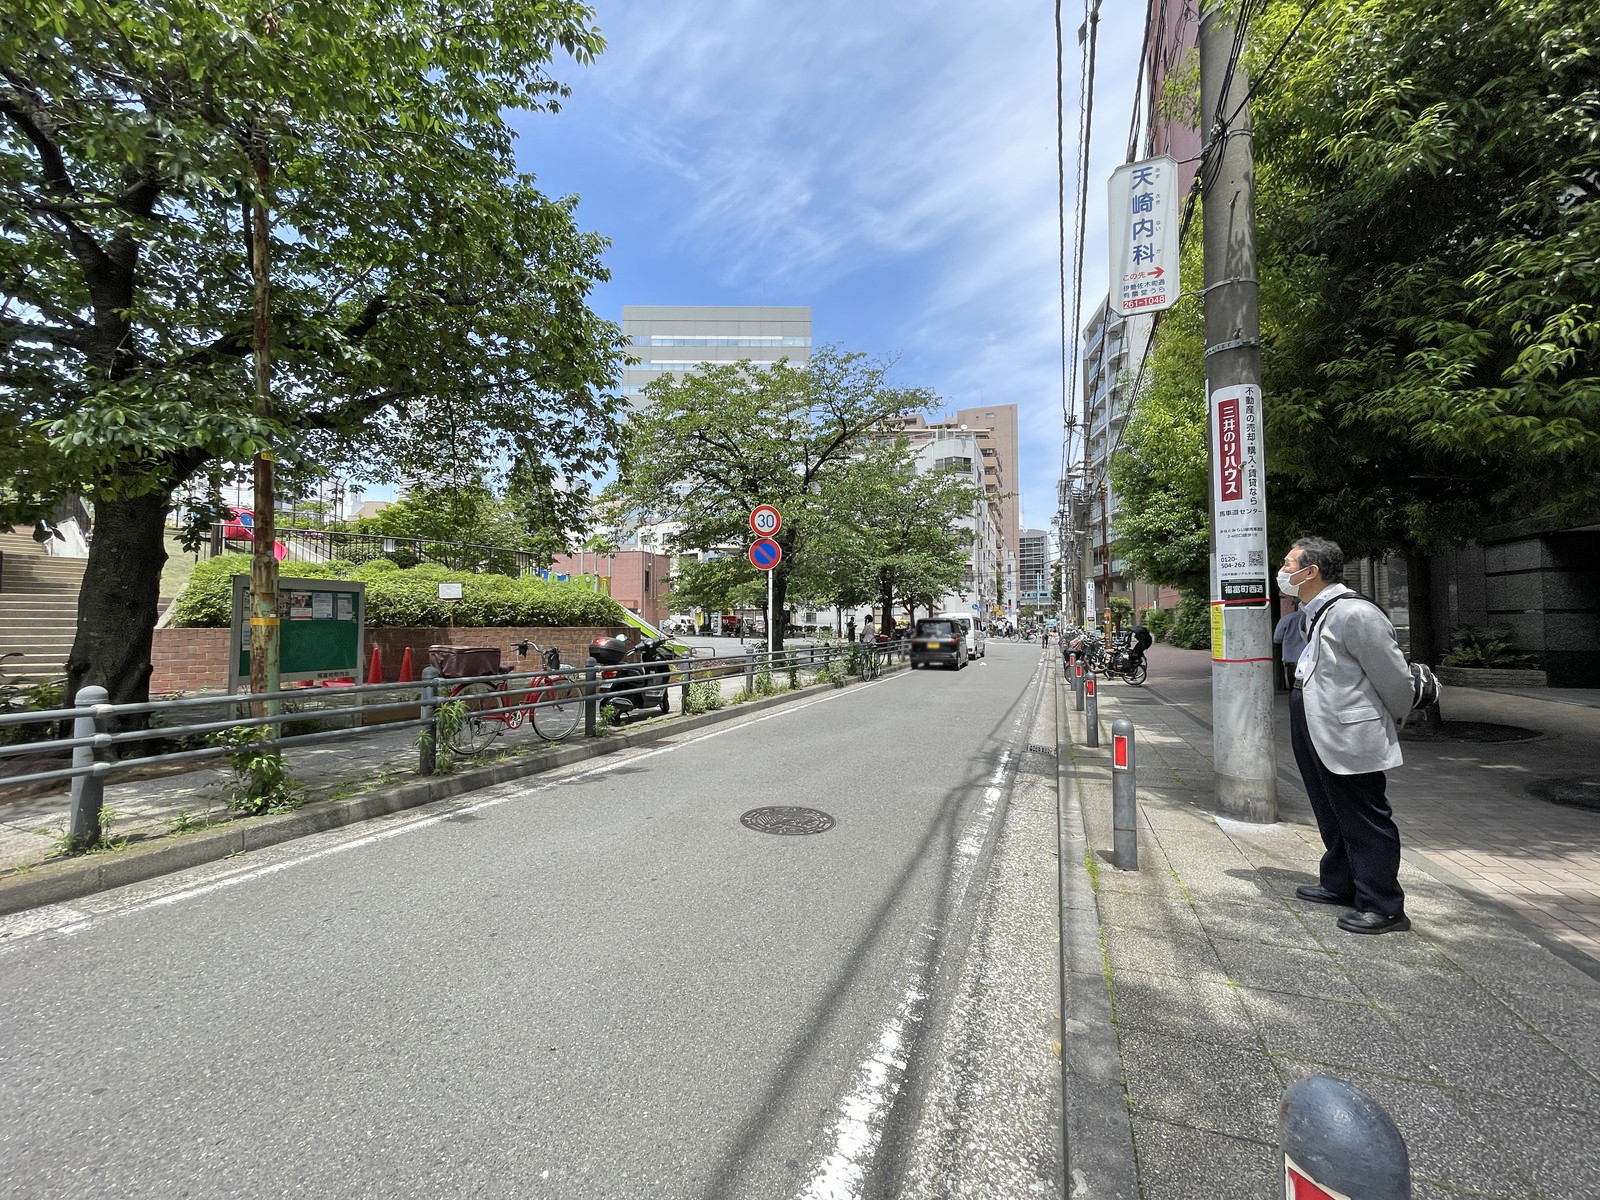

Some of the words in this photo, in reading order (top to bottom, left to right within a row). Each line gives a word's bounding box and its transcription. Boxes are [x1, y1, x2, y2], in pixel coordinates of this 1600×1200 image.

[1131, 166, 1155, 265] 天崎内科
[1123, 271, 1146, 281] この先
[1123, 295, 1165, 309] 261-1048
[1223, 405, 1238, 495] 三井のリハウス
[1245, 386, 1258, 506] 不動産の売却・購入・賃貸なら
[1219, 508, 1262, 517] 馬車道センター
[757, 513, 775, 528] 30
[1220, 561, 1246, 569] 504-262
[1224, 584, 1263, 594] 福富町西通
